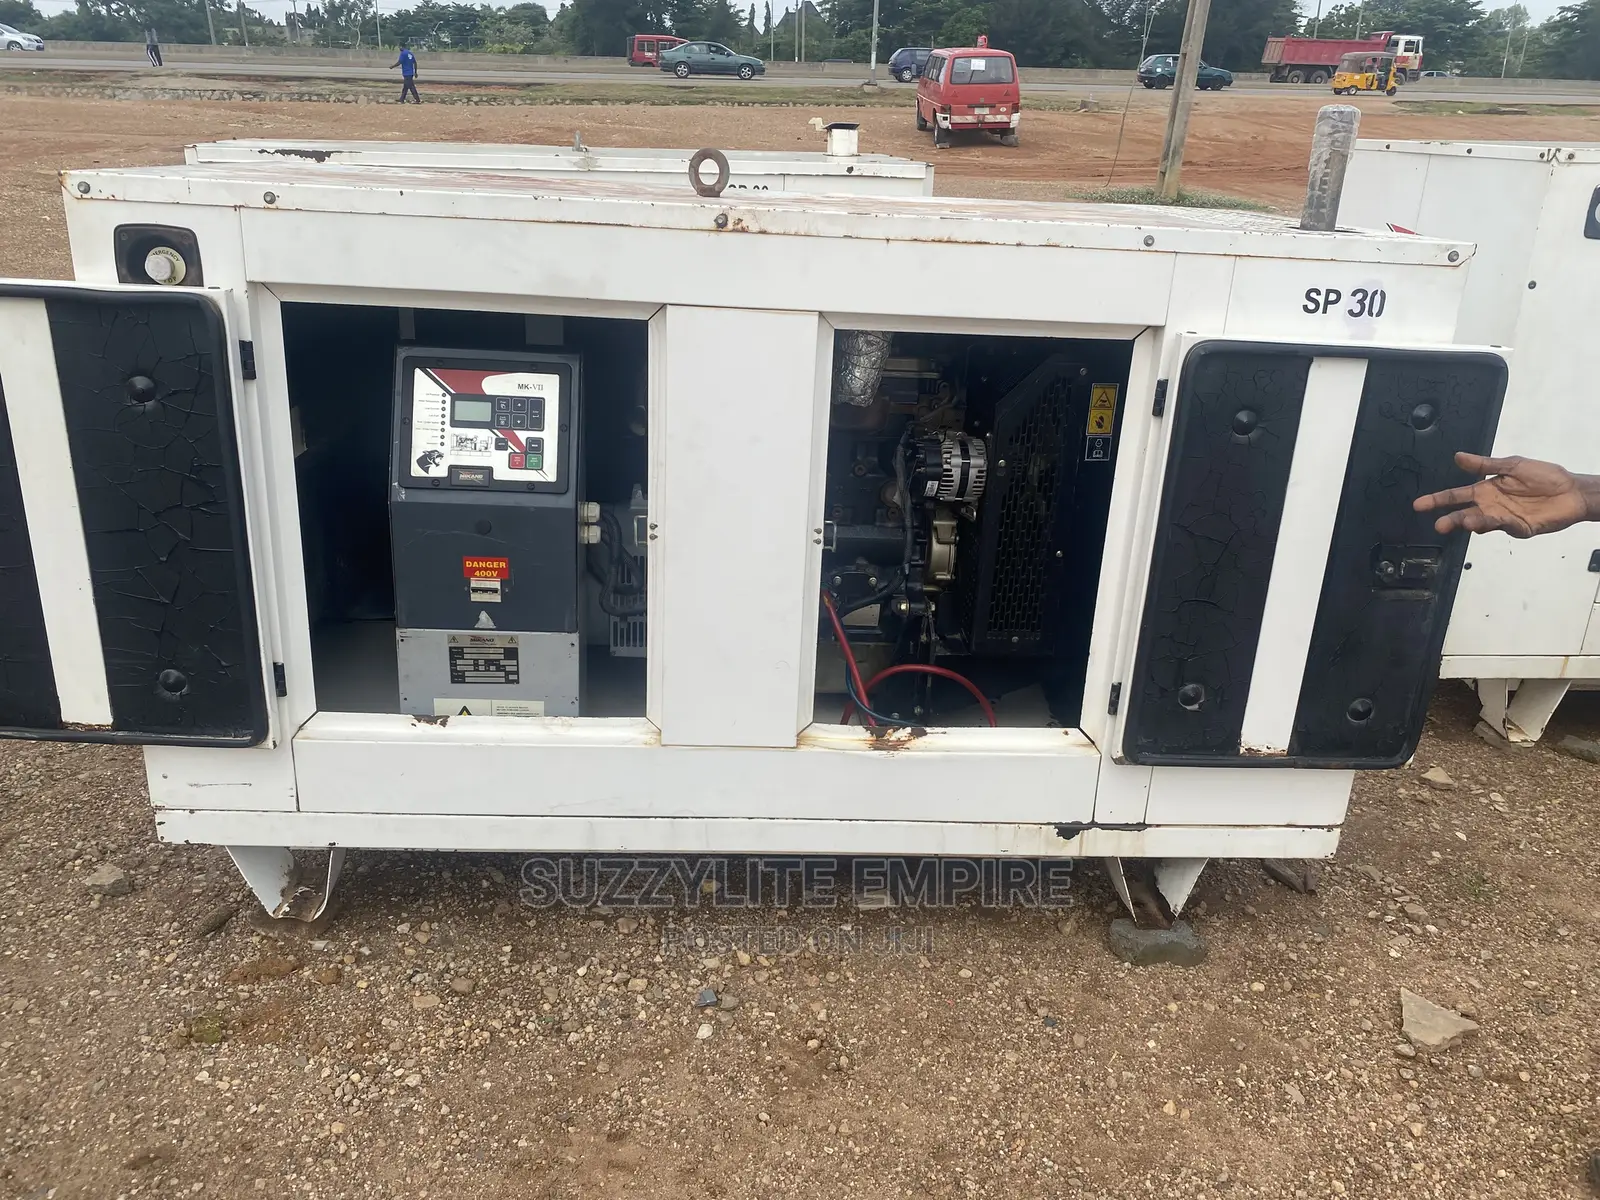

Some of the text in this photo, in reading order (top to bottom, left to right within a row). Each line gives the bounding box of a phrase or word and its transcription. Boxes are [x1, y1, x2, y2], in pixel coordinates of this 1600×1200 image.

[151, 250, 180, 261] MERGENCY
[1302, 287, 1387, 318] SP 30
